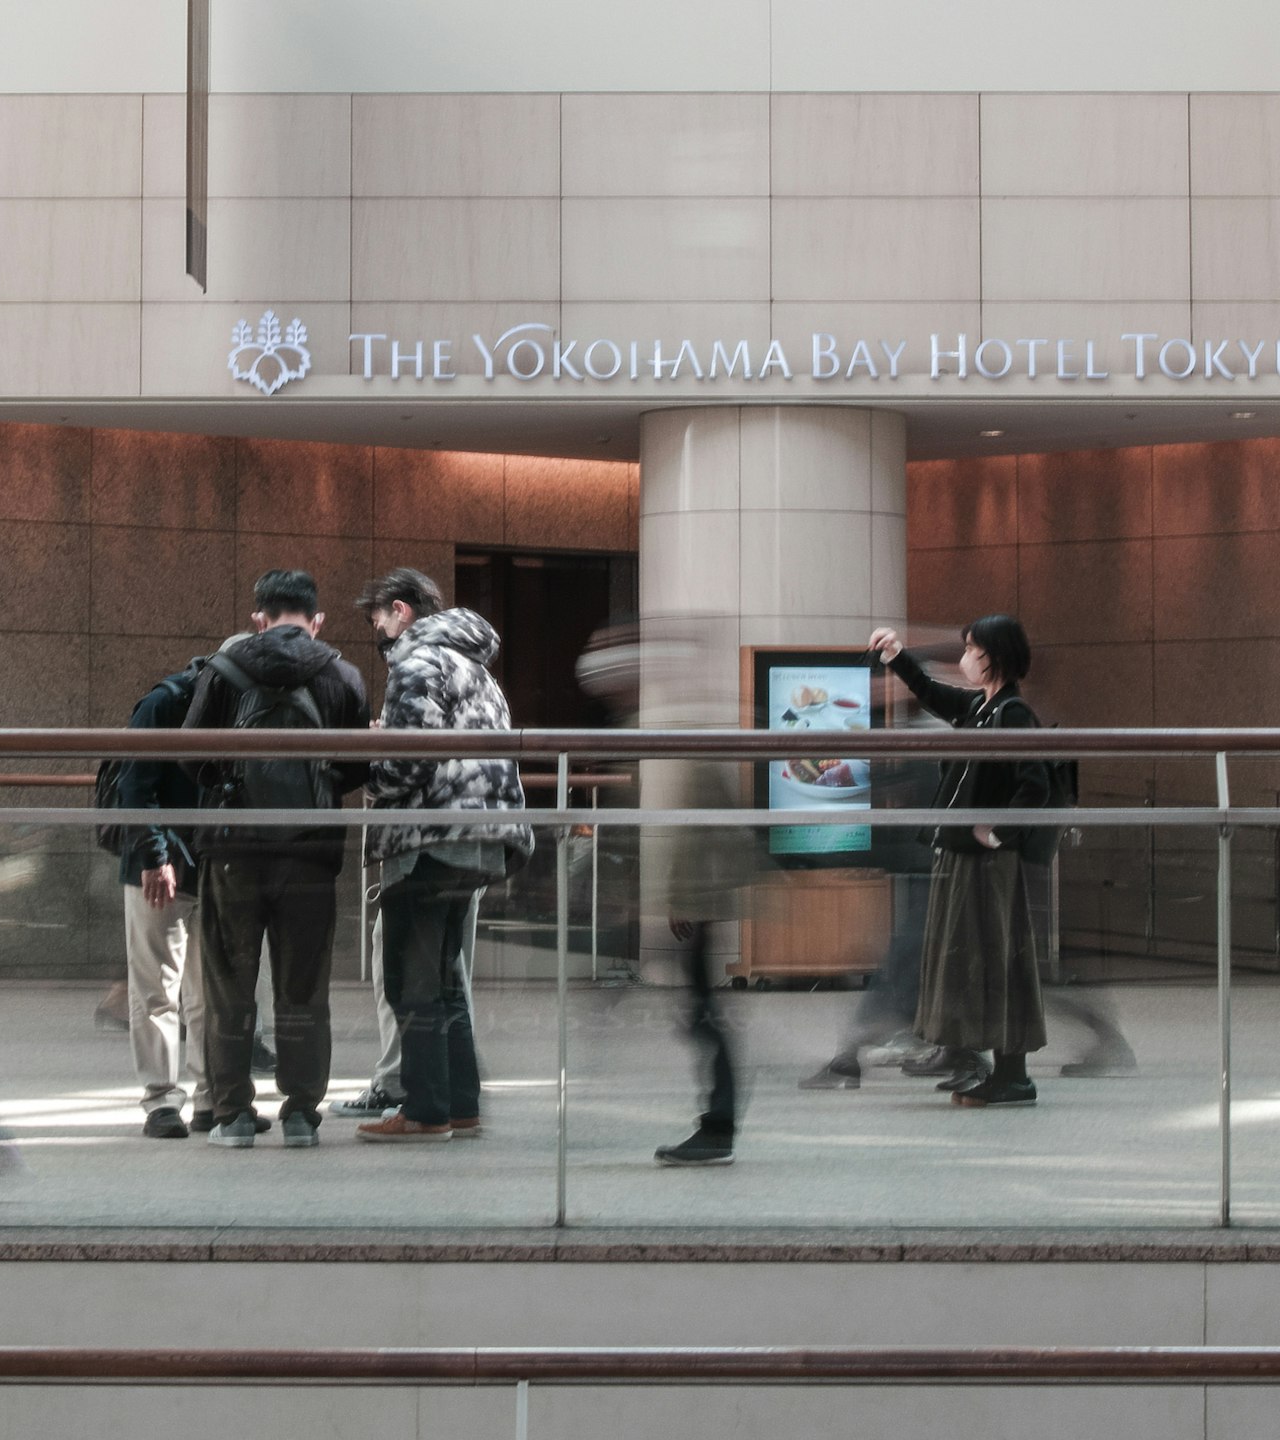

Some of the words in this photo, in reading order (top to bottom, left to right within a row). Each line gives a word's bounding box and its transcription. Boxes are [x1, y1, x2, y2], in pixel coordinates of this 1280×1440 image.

[349, 333, 456, 381] THE
[472, 322, 793, 382] YOKOHAMA
[812, 332, 907, 381] BAY
[929, 332, 1109, 381] HOTEL
